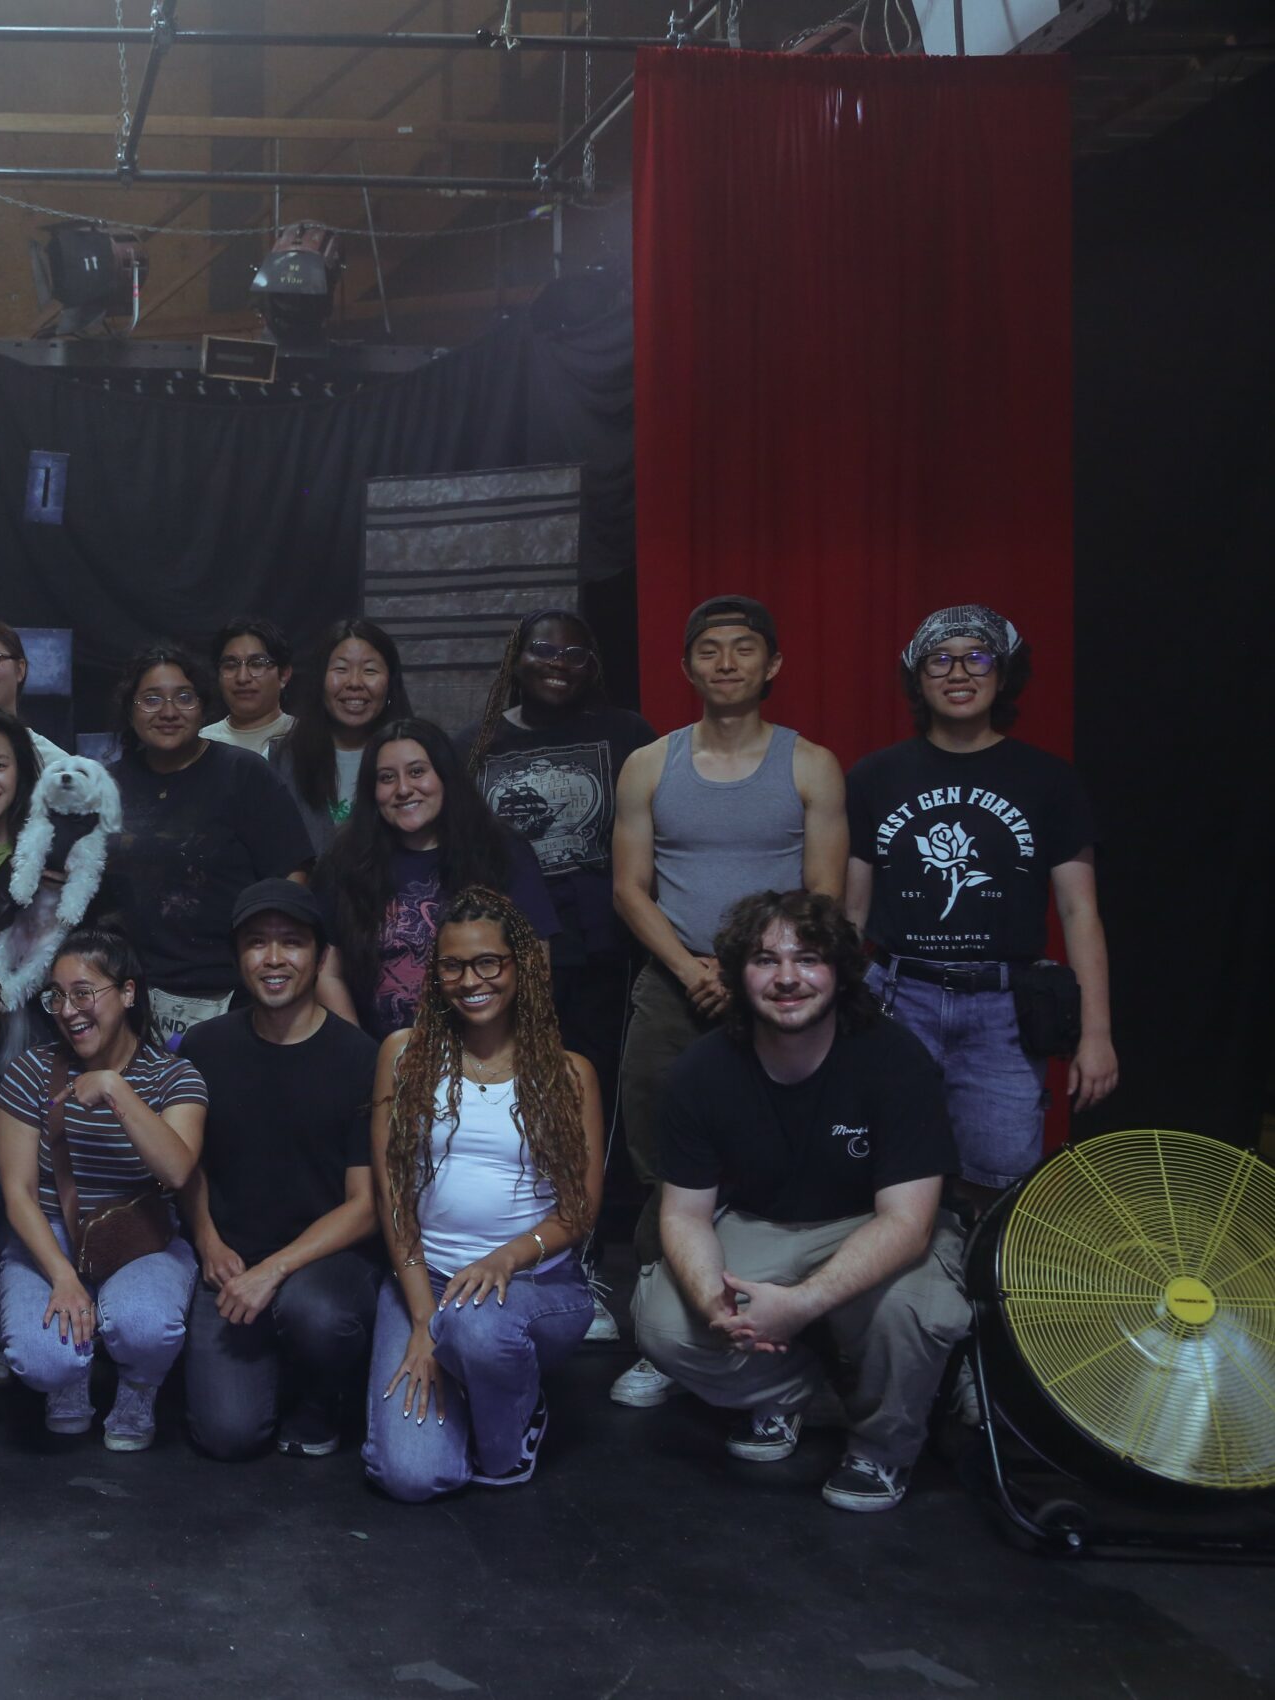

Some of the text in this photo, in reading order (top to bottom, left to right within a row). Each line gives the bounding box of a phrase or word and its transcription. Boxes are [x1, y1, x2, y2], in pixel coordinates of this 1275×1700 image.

[876, 786, 1035, 858] FIRST GEN FOREVER
